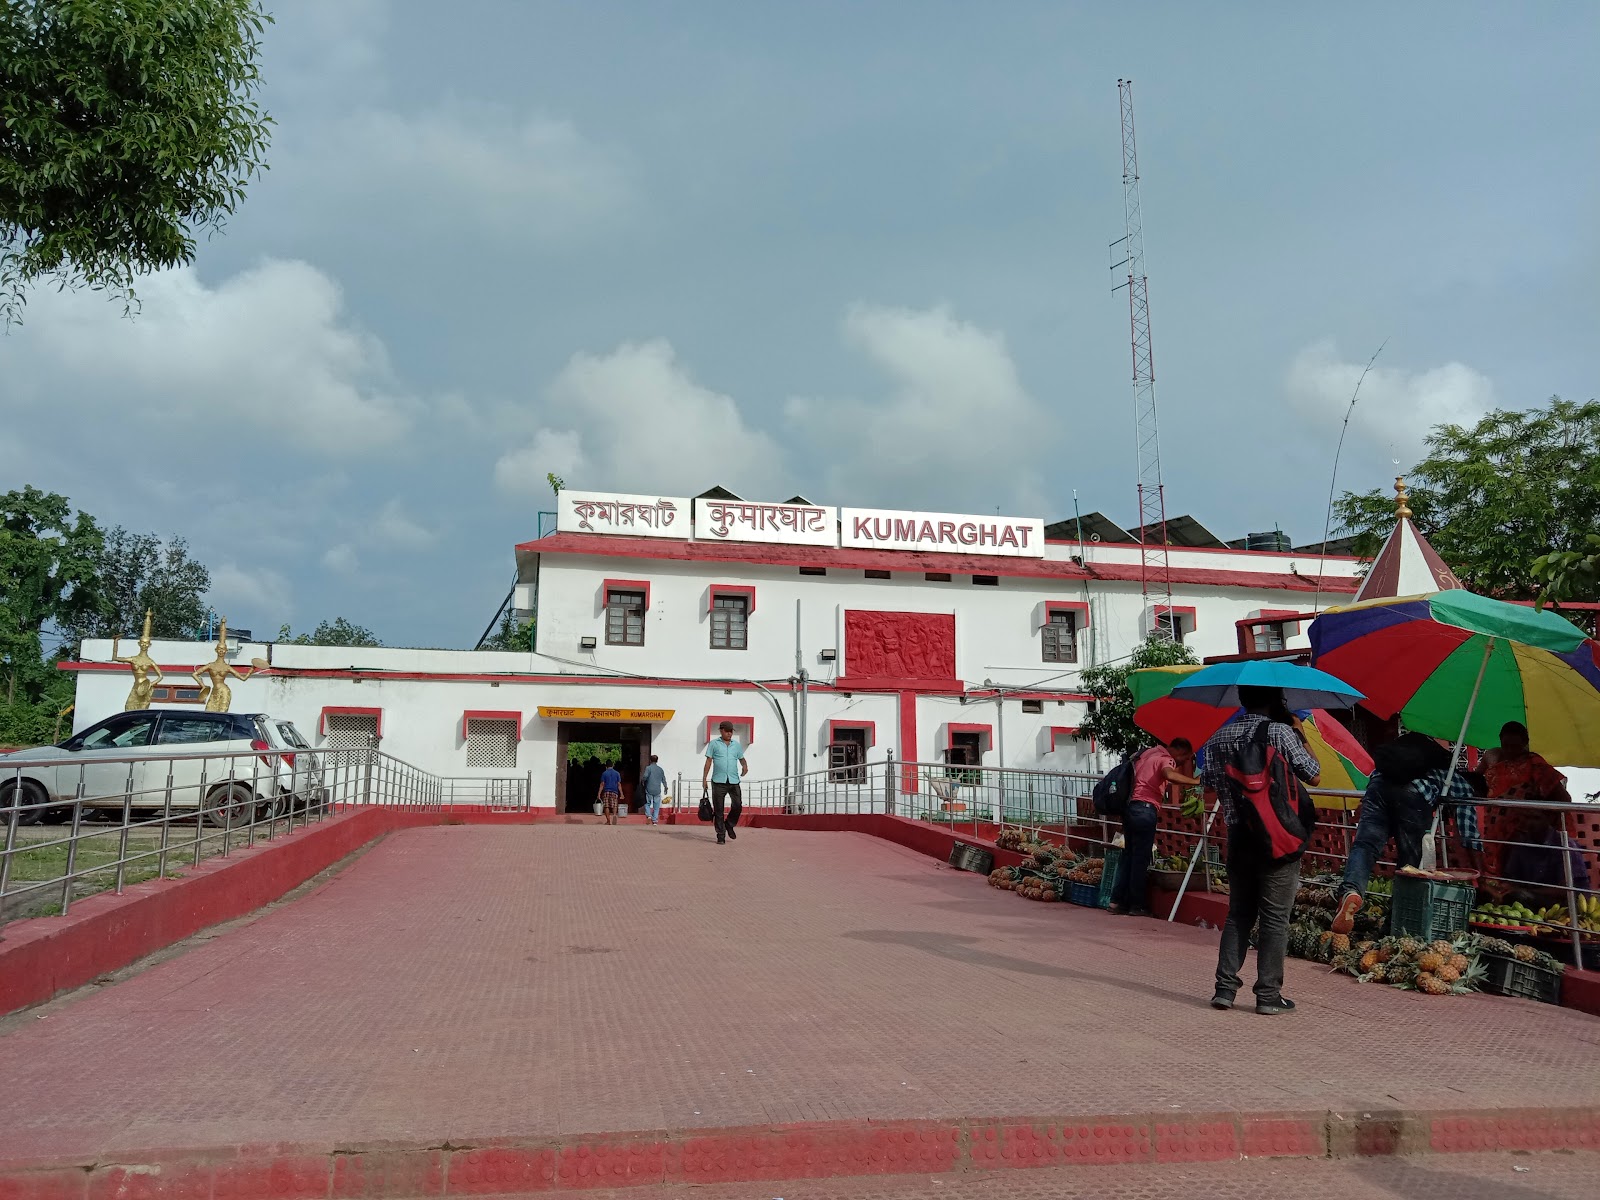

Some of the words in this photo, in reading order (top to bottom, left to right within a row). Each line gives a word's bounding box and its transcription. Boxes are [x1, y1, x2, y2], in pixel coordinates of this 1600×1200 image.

[572, 498, 677, 531] কুমারঘাট
[706, 501, 826, 537] कुमारघाट
[853, 516, 1033, 548] KUMARGHAT
[630, 711, 665, 719] KUMARGHAT
